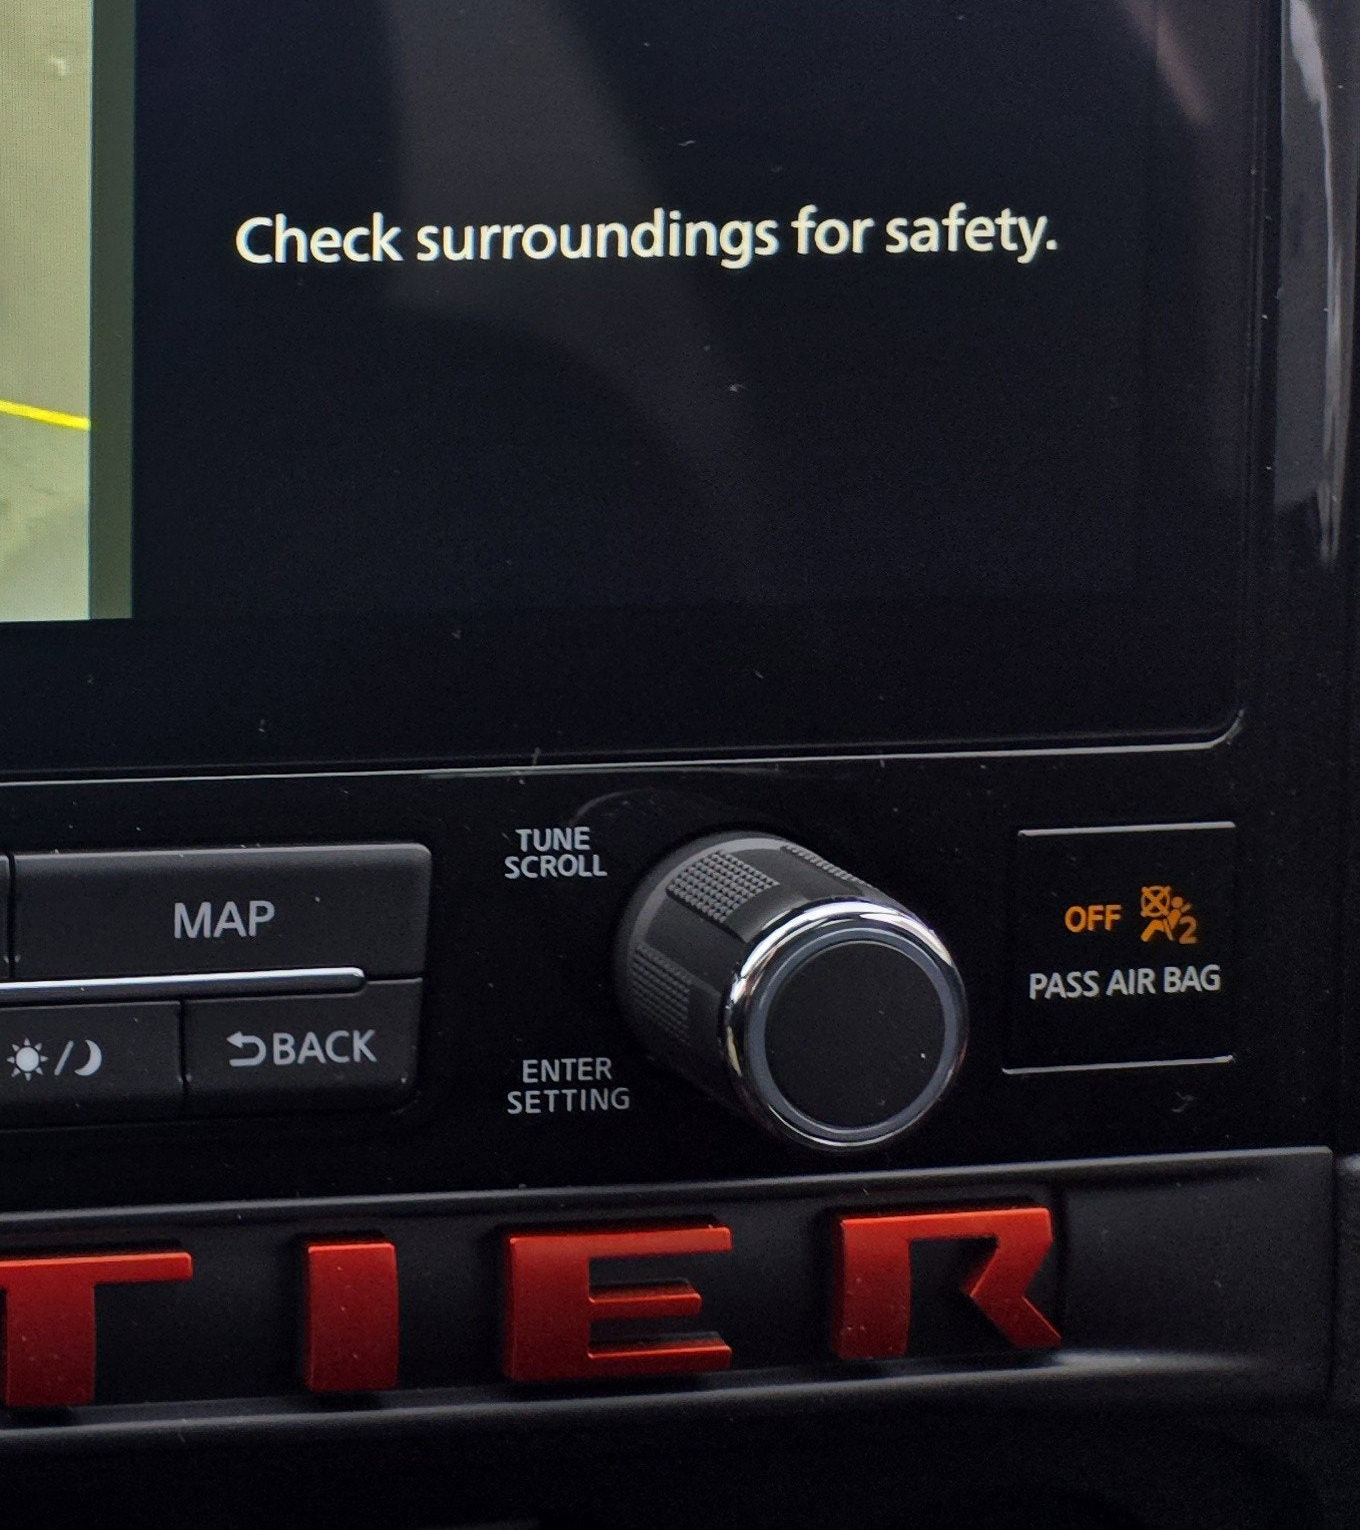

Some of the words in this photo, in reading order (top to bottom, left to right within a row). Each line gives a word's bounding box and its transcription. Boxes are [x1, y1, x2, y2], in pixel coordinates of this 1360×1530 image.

[234, 210, 404, 264] Check
[415, 207, 780, 269] surroundings
[790, 203, 876, 255] for
[884, 201, 1059, 264] safety.
[515, 826, 591, 852] TUNE
[503, 853, 609, 880] SCROLL
[173, 900, 276, 940] MAP
[1064, 904, 1122, 933] OFF
[1029, 970, 1100, 1000] PASS
[1105, 968, 1156, 997] AIR
[1163, 964, 1222, 994] BAG
[272, 1028, 377, 1066] BACK
[521, 1057, 613, 1085] ENTER
[506, 1086, 631, 1115] SETTING
